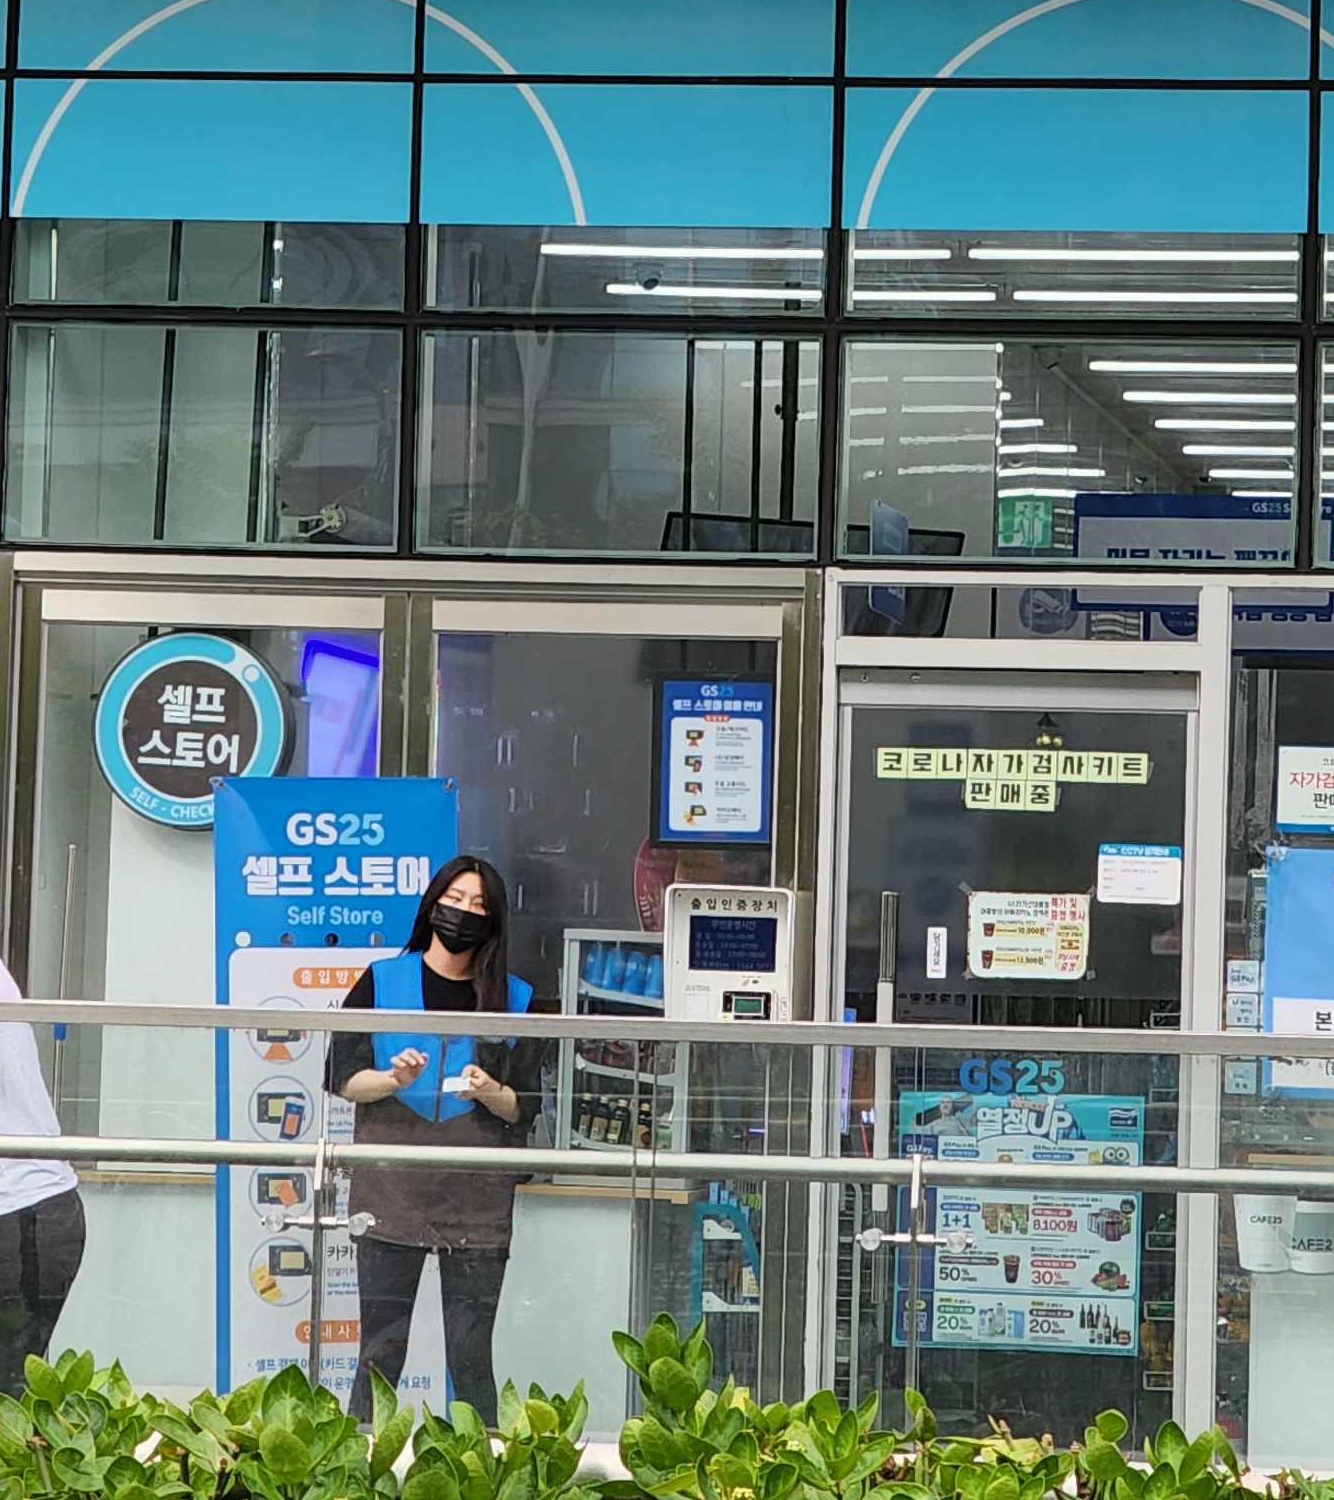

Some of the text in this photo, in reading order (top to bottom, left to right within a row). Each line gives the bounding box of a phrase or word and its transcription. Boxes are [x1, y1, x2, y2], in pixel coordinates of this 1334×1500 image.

[700, 685, 734, 697] GS25
[157, 685, 227, 725] 셀프
[137, 730, 240, 773] 스토어
[129, 786, 161, 810] SELF
[970, 781, 1051, 805] 판매중
[286, 812, 385, 846] GS25
[242, 856, 430, 896] 셀프 스토어
[287, 905, 384, 926] Self Store
[959, 1059, 1065, 1093] GS25
[941, 1213, 971, 1228] 1+1
[1250, 1215, 1283, 1225] CAFE25
